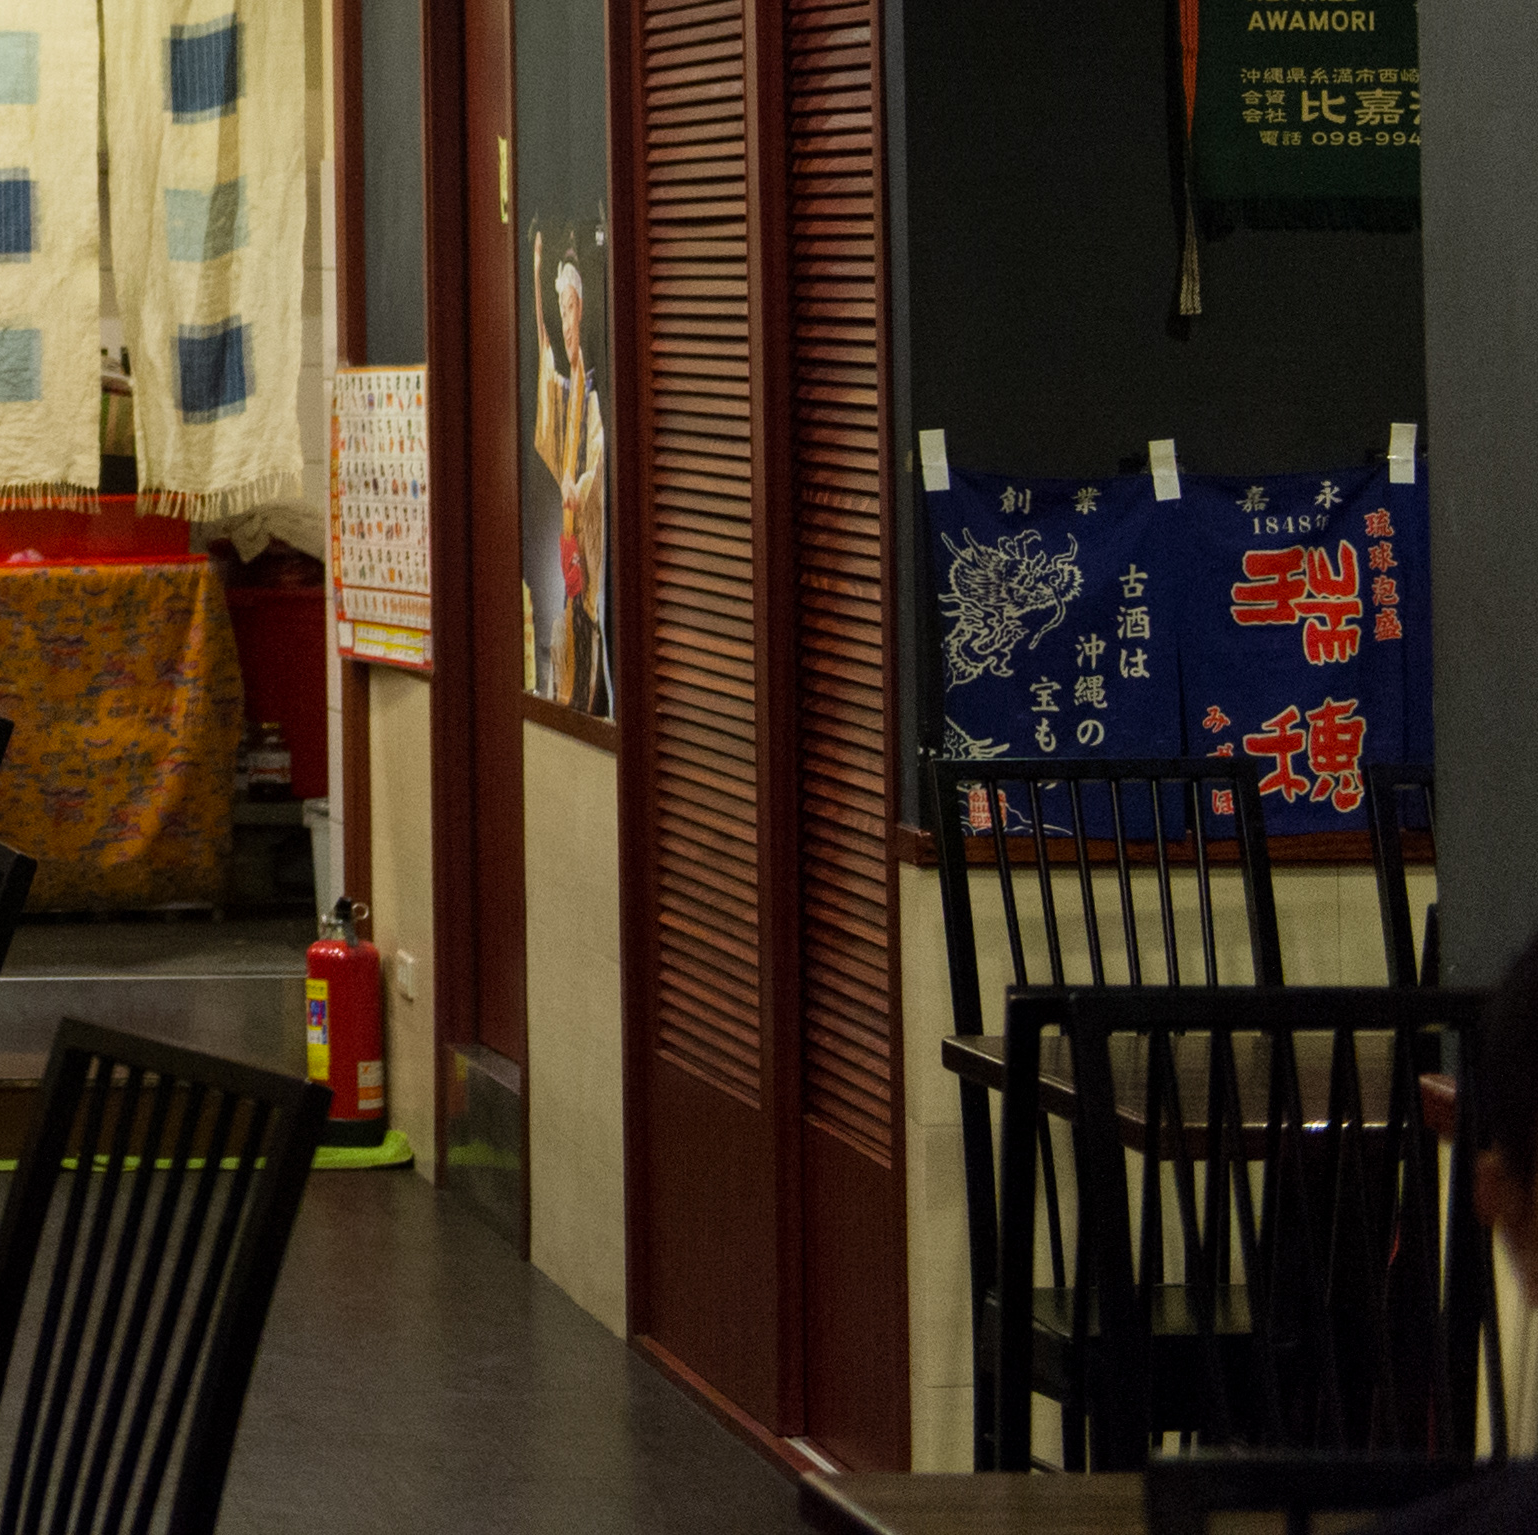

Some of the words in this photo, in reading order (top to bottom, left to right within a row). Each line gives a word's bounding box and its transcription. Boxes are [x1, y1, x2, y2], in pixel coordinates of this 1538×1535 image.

[1247, 10, 1375, 32] AWAMORI
[1259, 130, 1302, 146] 電話
[999, 486, 1102, 516] 創業
[1236, 480, 1343, 512] 嘉永
[1116, 564, 1152, 680] 古酒は
[1364, 508, 1403, 642] 琉球泡盛
[1029, 675, 1062, 789] 宝も
[1073, 632, 1108, 747] 沖縄の
